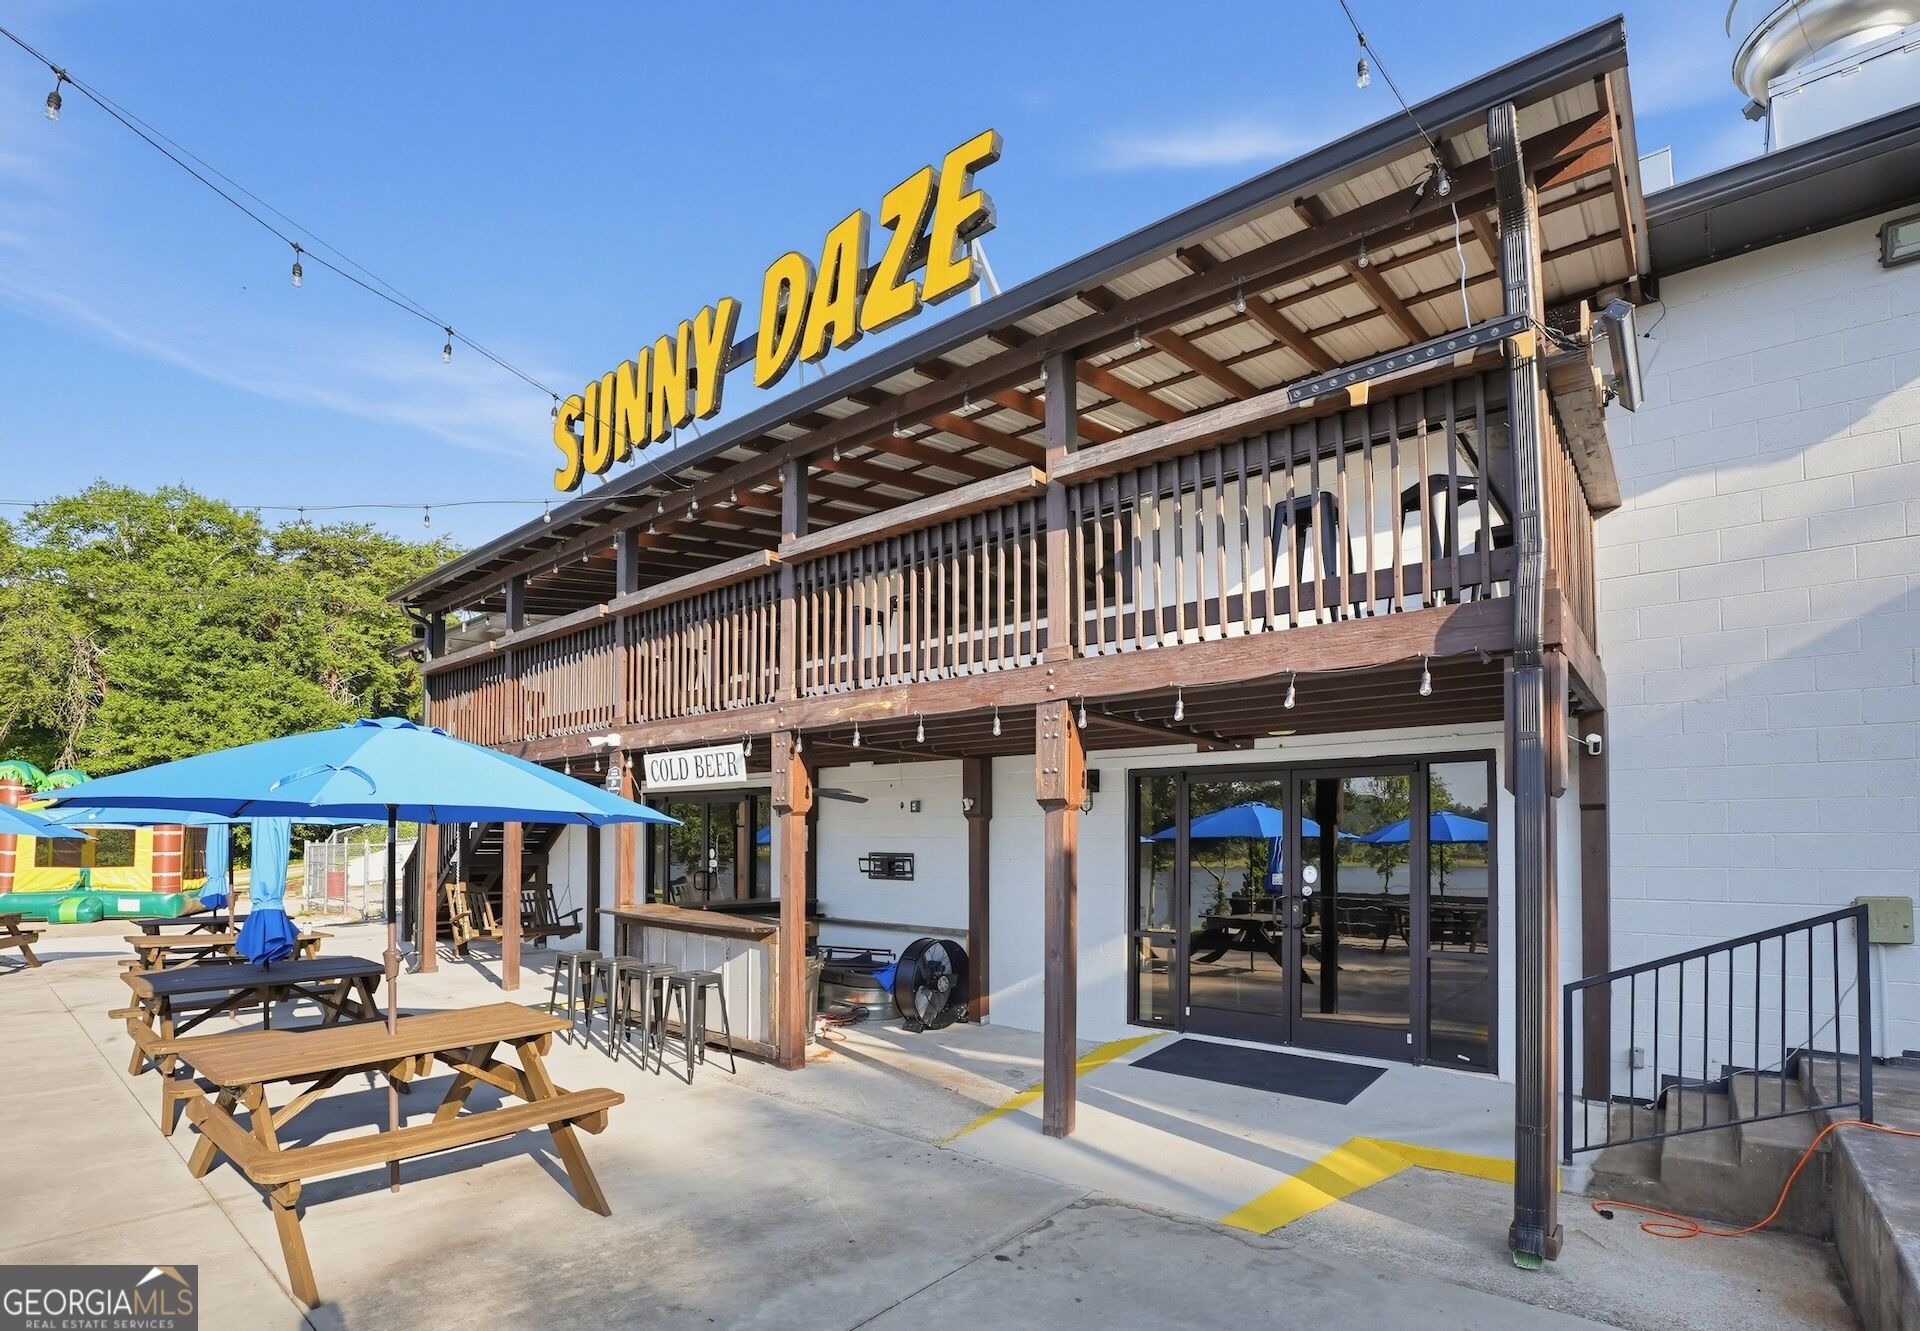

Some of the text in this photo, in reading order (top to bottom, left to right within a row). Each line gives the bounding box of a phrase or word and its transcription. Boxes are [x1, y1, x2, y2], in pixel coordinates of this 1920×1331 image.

[553, 128, 1003, 492] SUNNY DAZE
[650, 751, 738, 783] COLD BEER
